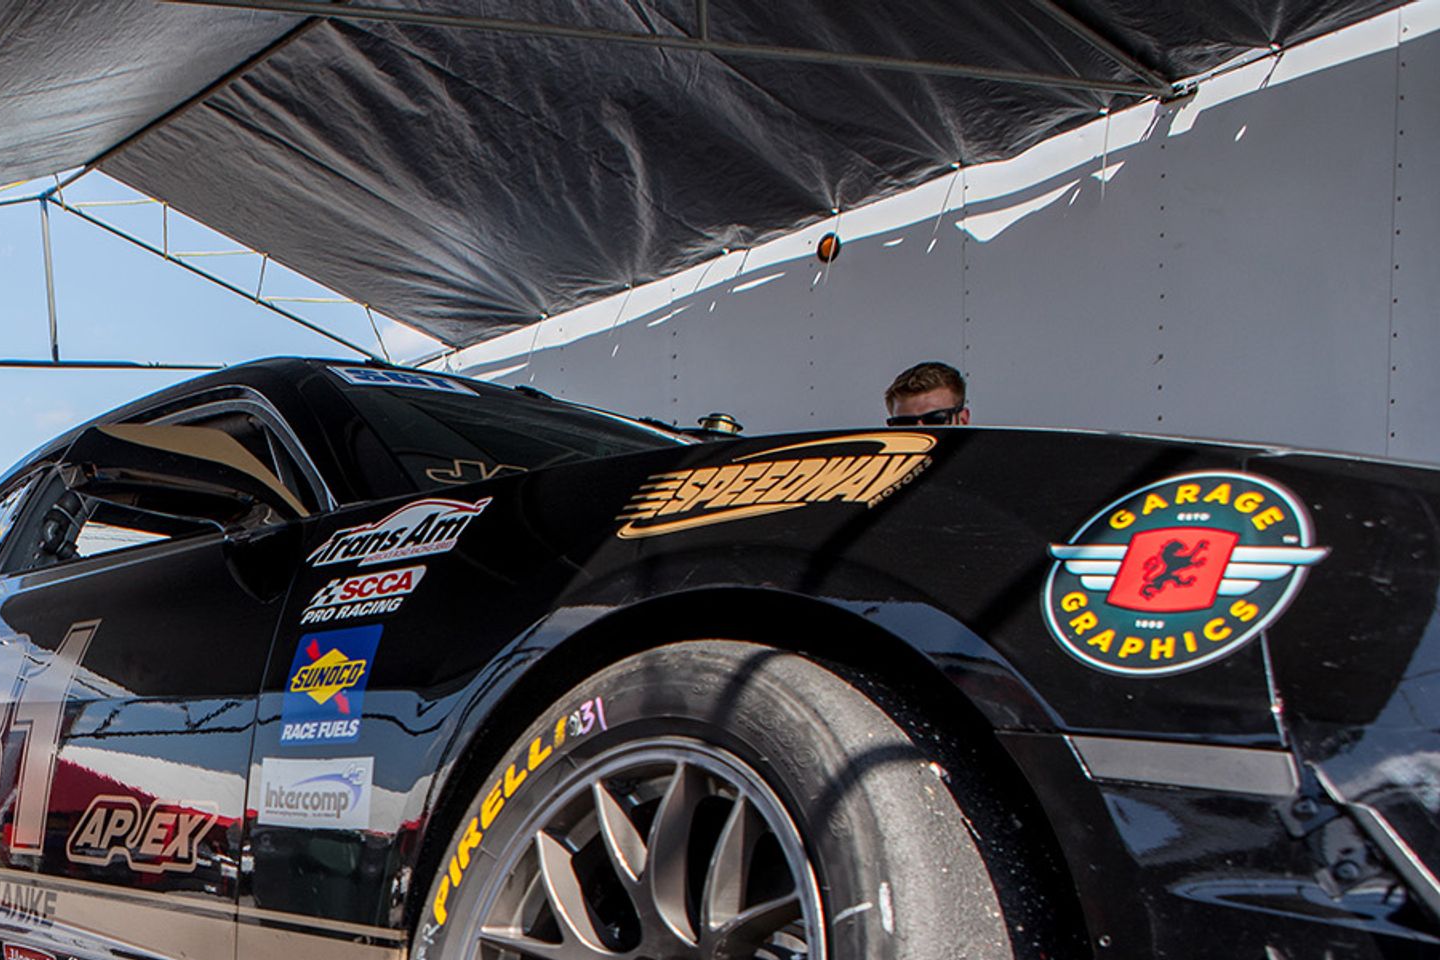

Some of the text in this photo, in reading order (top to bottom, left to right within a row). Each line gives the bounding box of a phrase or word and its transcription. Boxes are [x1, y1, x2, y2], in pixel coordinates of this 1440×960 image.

[652, 455, 932, 517] SPEEDWAY
[868, 456, 933, 509] MOTORS
[1109, 483, 1285, 531] GARAGE
[339, 571, 413, 600] SCCA
[299, 597, 405, 625] PRO RACING
[1061, 591, 1259, 661] GRAPHICS
[293, 662, 364, 689] SUNOCO
[281, 719, 360, 740] RACE FUELS
[265, 781, 350, 819] Intercomp
[433, 715, 568, 926] PIRELLI
[71, 801, 211, 861] APEX
